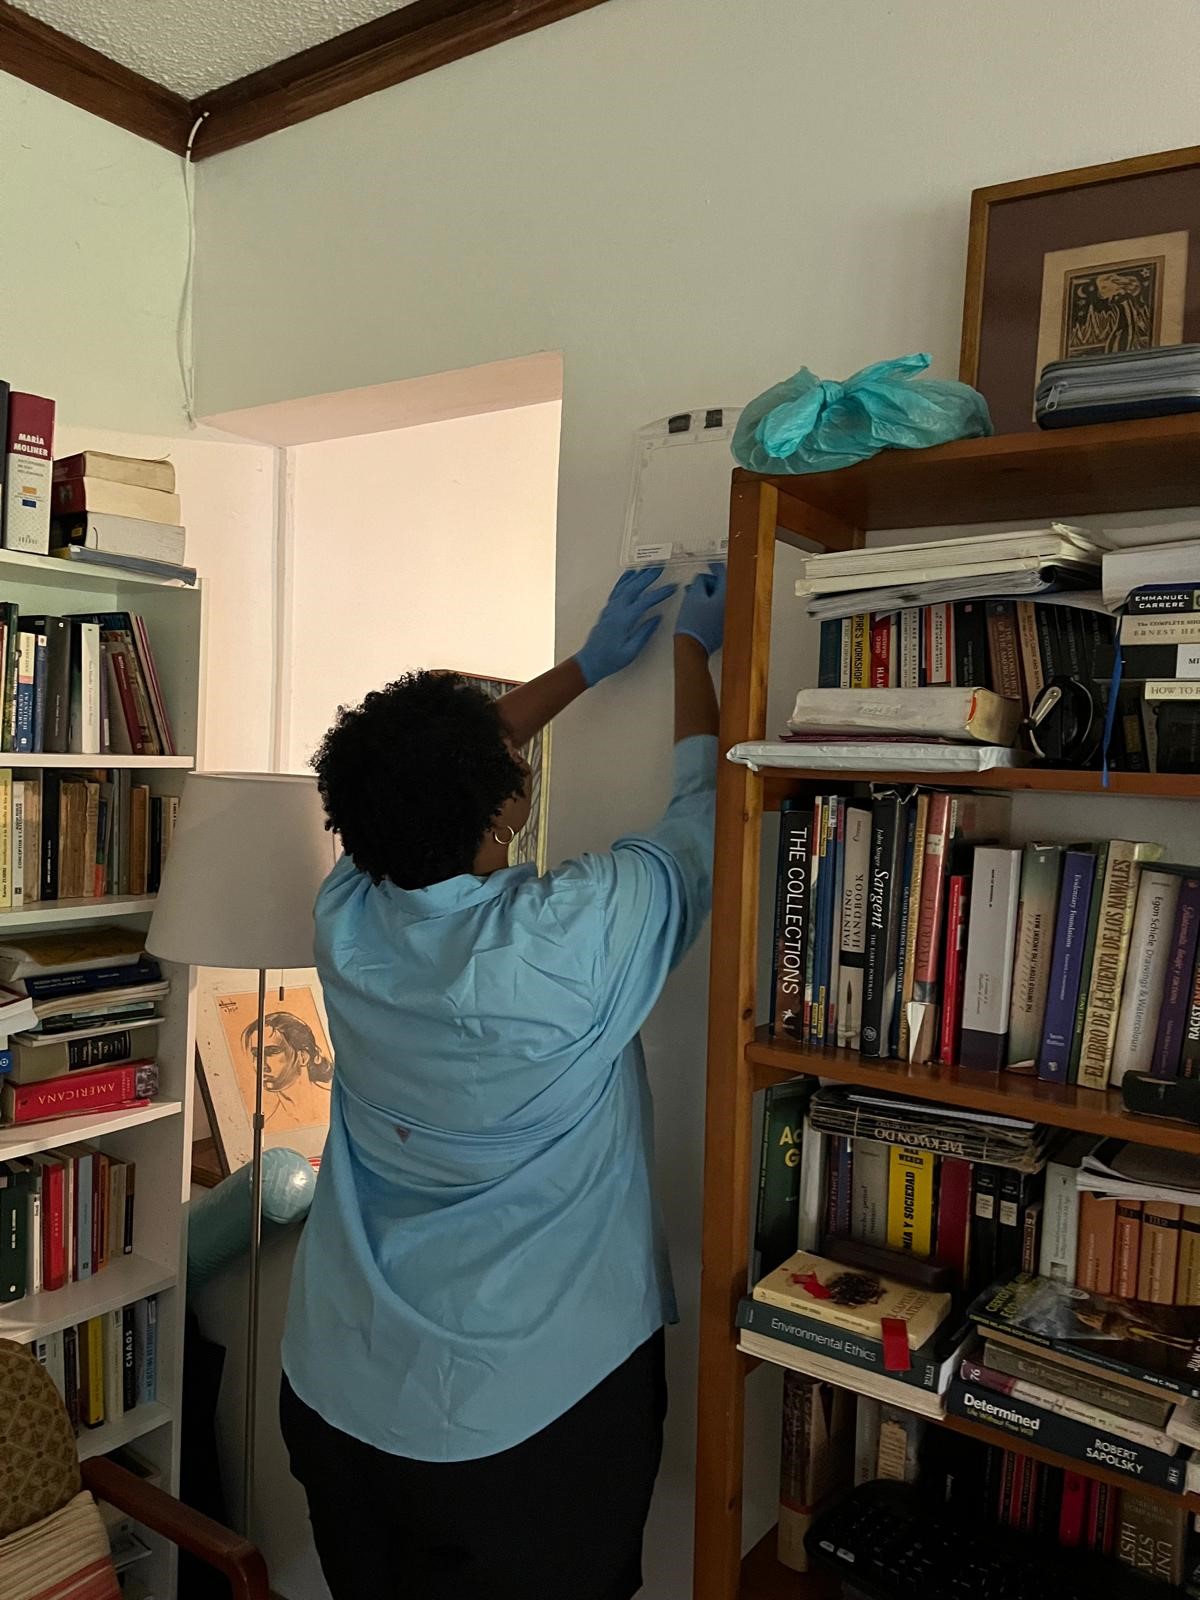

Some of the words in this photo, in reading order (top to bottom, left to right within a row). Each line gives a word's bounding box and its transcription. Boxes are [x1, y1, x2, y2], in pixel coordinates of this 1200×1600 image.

[13, 442, 49, 457] MOLINER
[18, 433, 45, 446] MARÍA
[1135, 594, 1190, 602] EMMANUEL
[854, 613, 865, 639] PIRE'S
[1134, 628, 1176, 636] ERNEST
[853, 640, 864, 682] WORKSHOP
[1151, 686, 1177, 695] HOW
[1179, 686, 1192, 695] TO
[789, 827, 807, 863] THE
[876, 828, 884, 845] John
[870, 868, 890, 930] Sargent
[1106, 859, 1132, 910] NAWALES
[843, 889, 853, 946] PAINTING
[852, 873, 864, 949] HANDBOOK
[1150, 896, 1164, 917] Egon
[782, 867, 805, 996] COLLECTIONS
[1065, 909, 1078, 948] Foundations
[1104, 910, 1124, 933] LOS
[1146, 918, 1161, 947] Schiele
[1102, 933, 1121, 950] DE
[1026, 982, 1035, 1003] UNTOLD
[1032, 930, 1040, 953] ANCIENT
[1096, 952, 1120, 994] CUENTA
[1138, 949, 1155, 988] Drawings
[1093, 997, 1115, 1012] LA
[1091, 1011, 1112, 1029] DE
[1129, 998, 1147, 1053] Watercolours
[1087, 1029, 1109, 1064] LIBRO
[1086, 1065, 1104, 1079] EL
[37, 1081, 117, 1106] AMERICANA
[898, 1153, 924, 1166] WEBER
[903, 1171, 915, 1220] SOCIEDAD
[125, 1329, 133, 1368] CHAOS
[770, 1317, 843, 1350] Environmental
[844, 1341, 877, 1363] Ethics
[969, 1367, 982, 1381] 76
[963, 1392, 1041, 1431] Determined
[1085, 1446, 1145, 1475] SAPOLSKY
[1095, 1437, 1139, 1460] ROBERT
